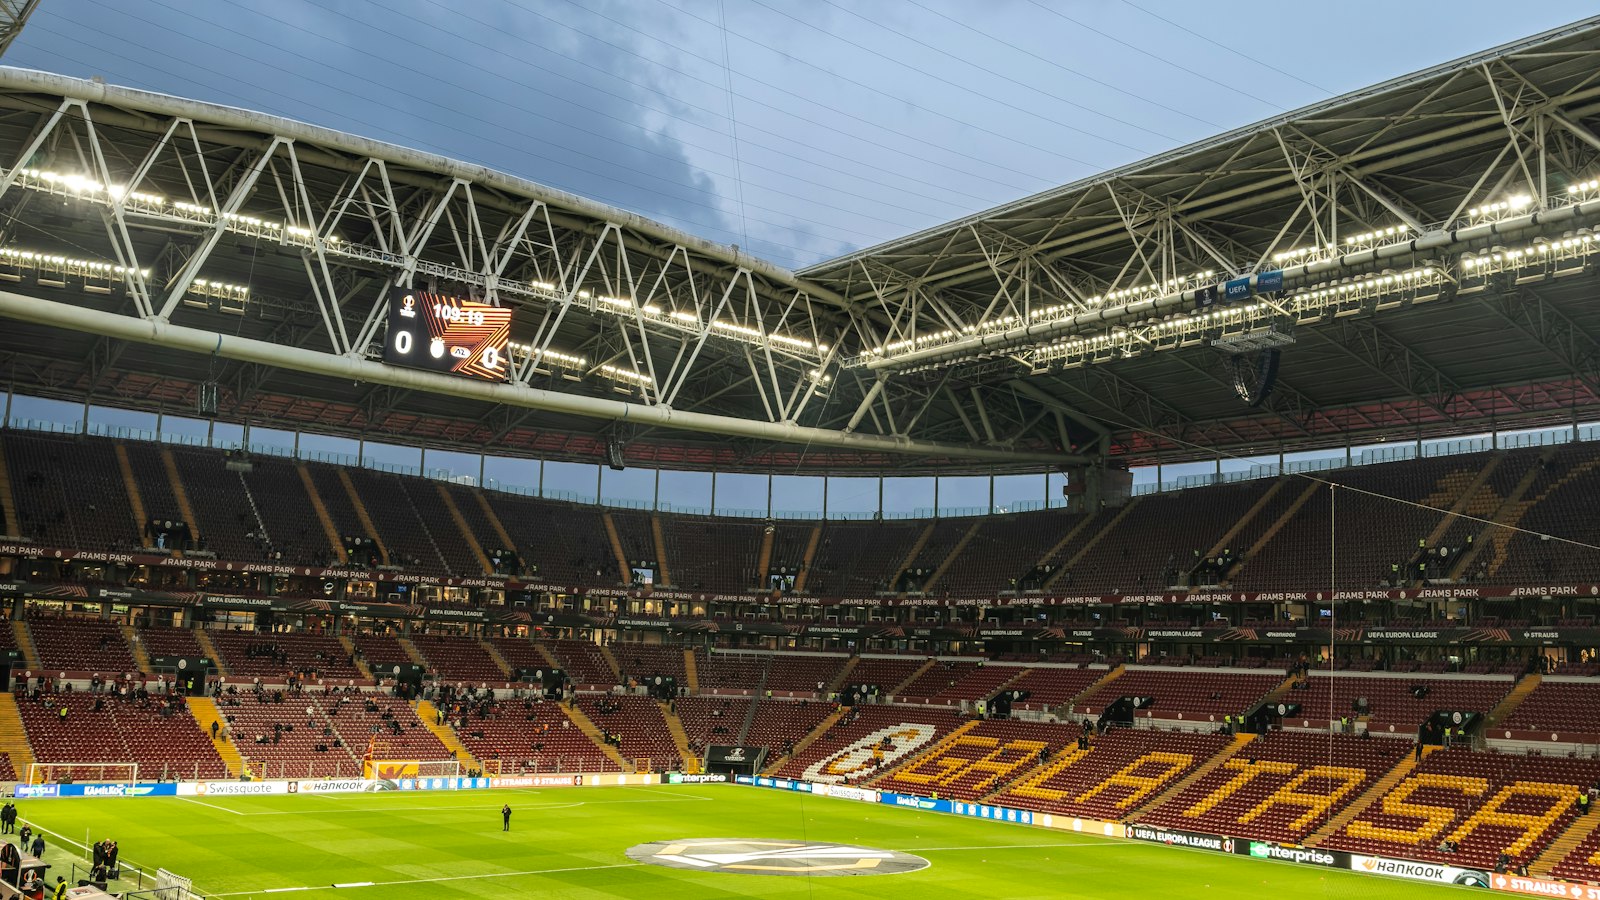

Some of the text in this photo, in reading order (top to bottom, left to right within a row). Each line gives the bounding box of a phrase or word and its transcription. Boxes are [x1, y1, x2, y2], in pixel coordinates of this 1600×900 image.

[1228, 284, 1246, 294] UEFA
[395, 330, 412, 354] 0
[0, 546, 44, 556] MS PARK
[80, 552, 133, 562] RAMS PARK
[168, 558, 216, 569] RAMS PARK
[274, 566, 296, 574] PARK
[1519, 586, 1577, 596] RAMS PARK
[210, 784, 272, 794] Swissquote
[1136, 830, 1221, 849] UEFA EUROPA LEAGUE
[1255, 845, 1334, 864] enterprise
[1511, 879, 1566, 896] STRAUSS
